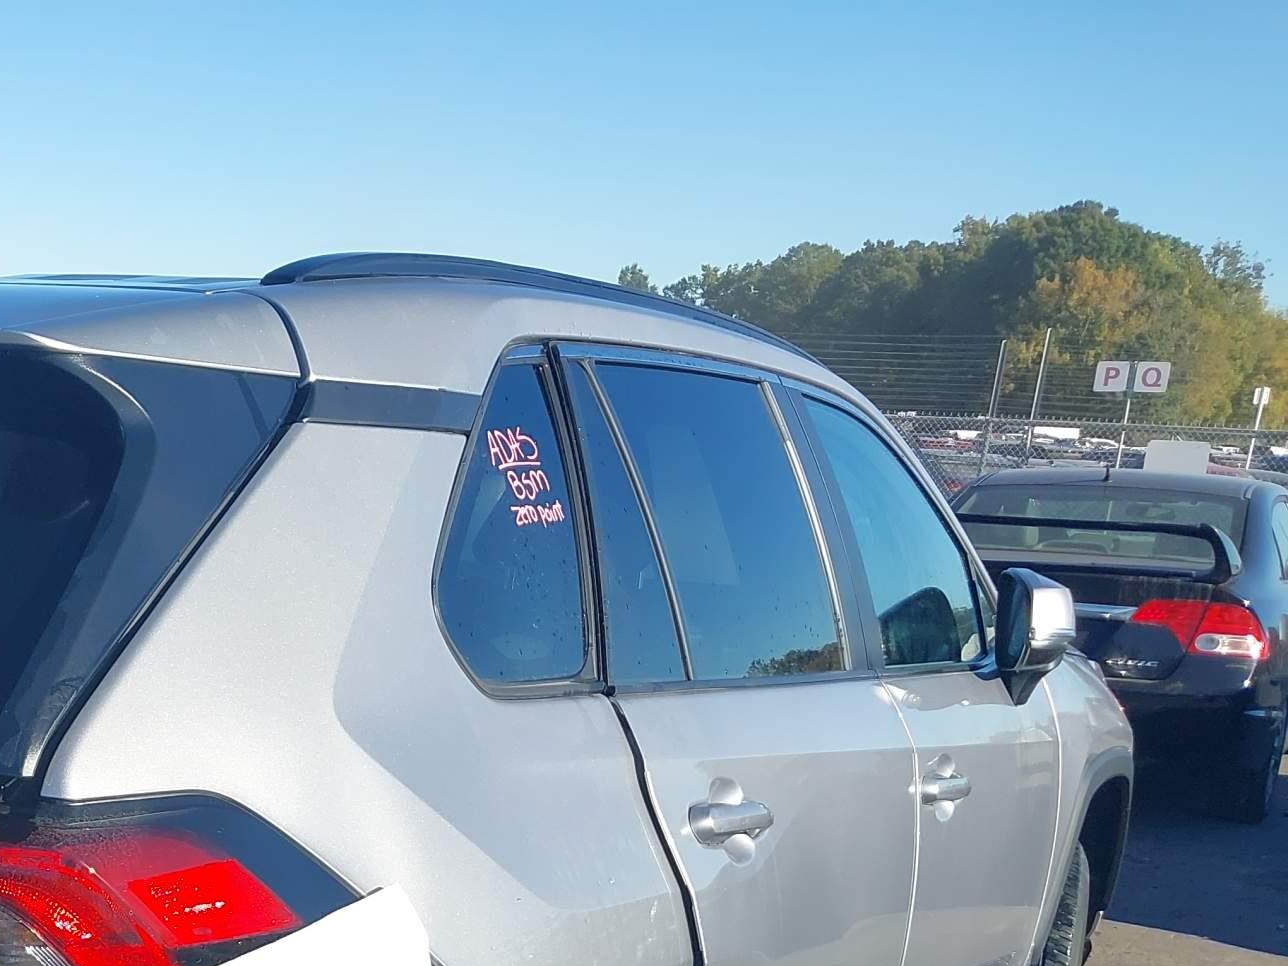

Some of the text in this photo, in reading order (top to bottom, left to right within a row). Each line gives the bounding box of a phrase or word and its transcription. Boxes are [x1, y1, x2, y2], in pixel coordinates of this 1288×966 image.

[1103, 366, 1121, 387] P
[1141, 366, 1162, 388] Q
[486, 426, 539, 467] ADAS
[506, 470, 551, 500] BSM
